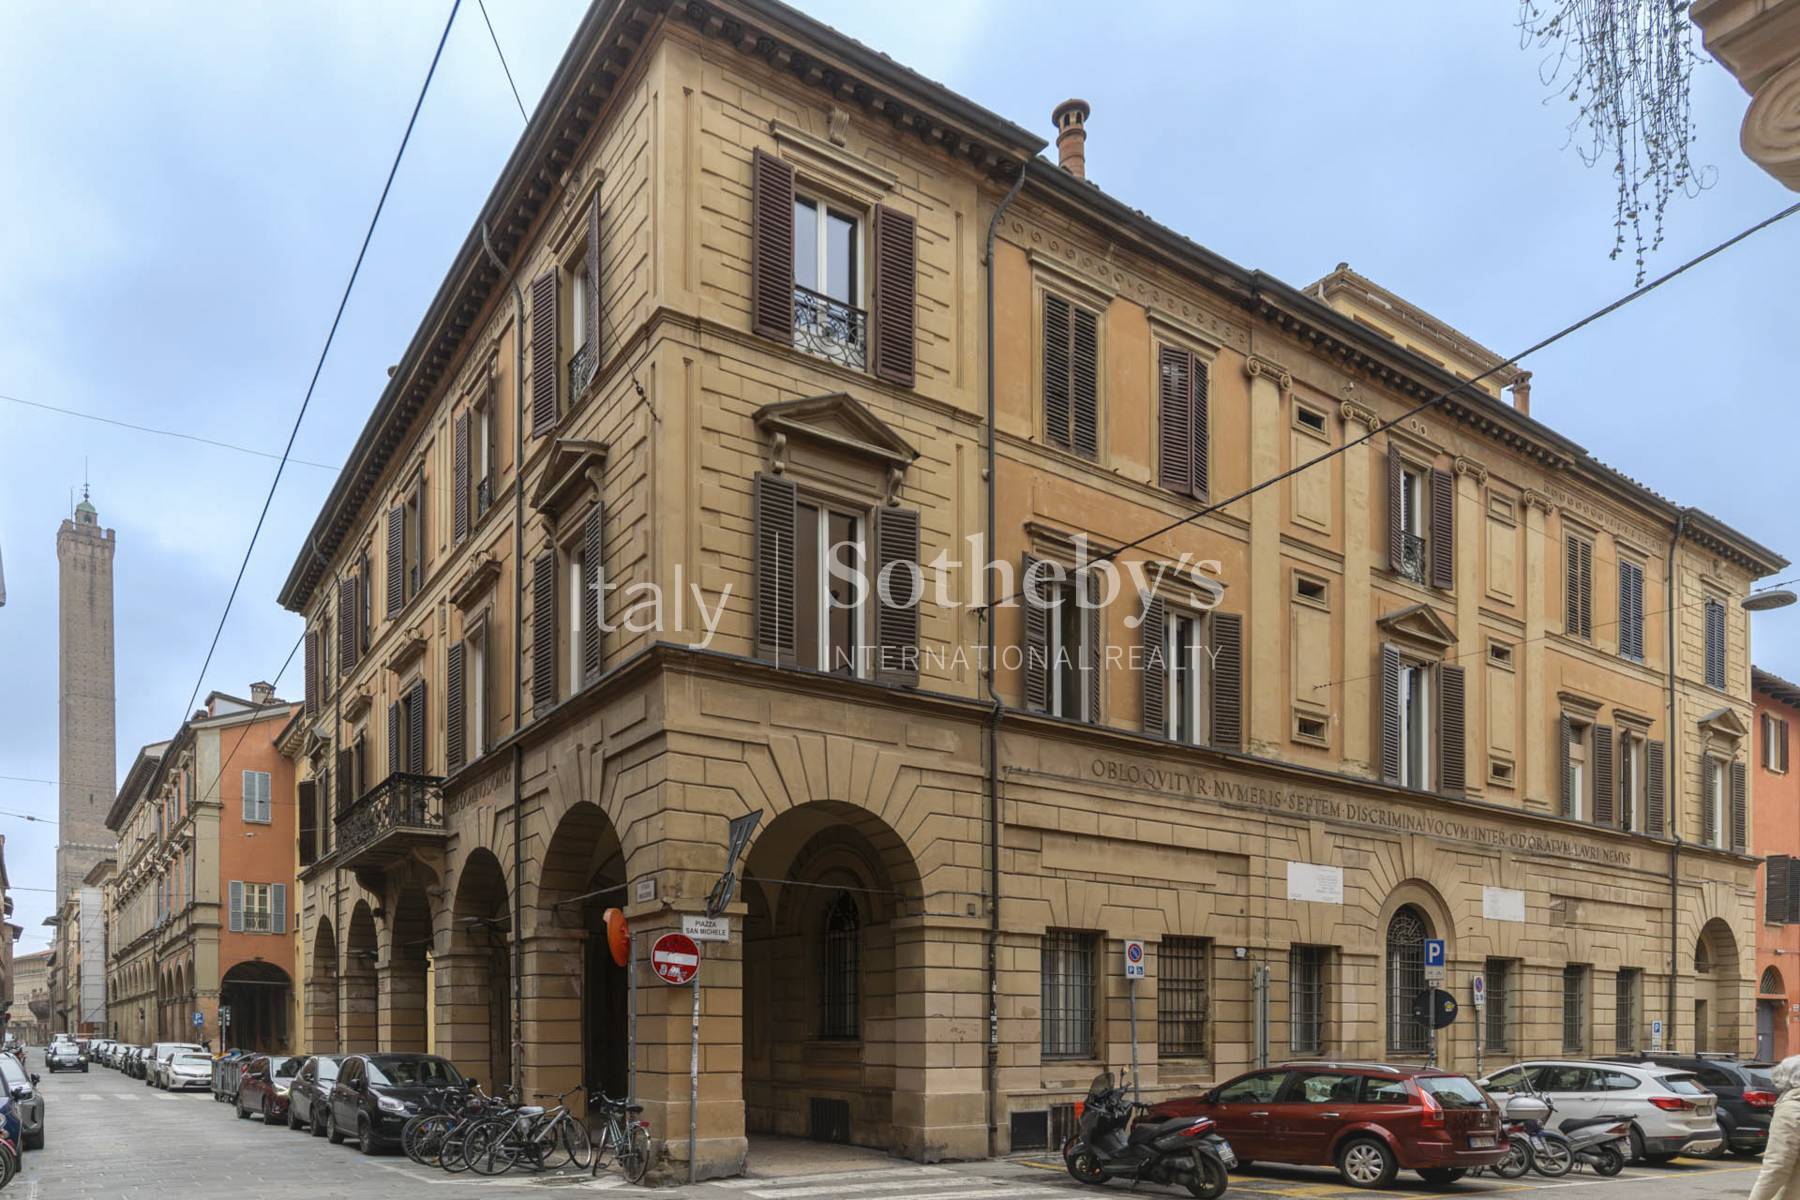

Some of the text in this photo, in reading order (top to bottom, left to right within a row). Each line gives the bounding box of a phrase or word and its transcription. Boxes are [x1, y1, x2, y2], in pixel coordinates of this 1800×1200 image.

[695, 920, 717, 928] PIAZZA
[685, 927, 727, 936] SAN MICHELE
[1429, 943, 1441, 963] P
